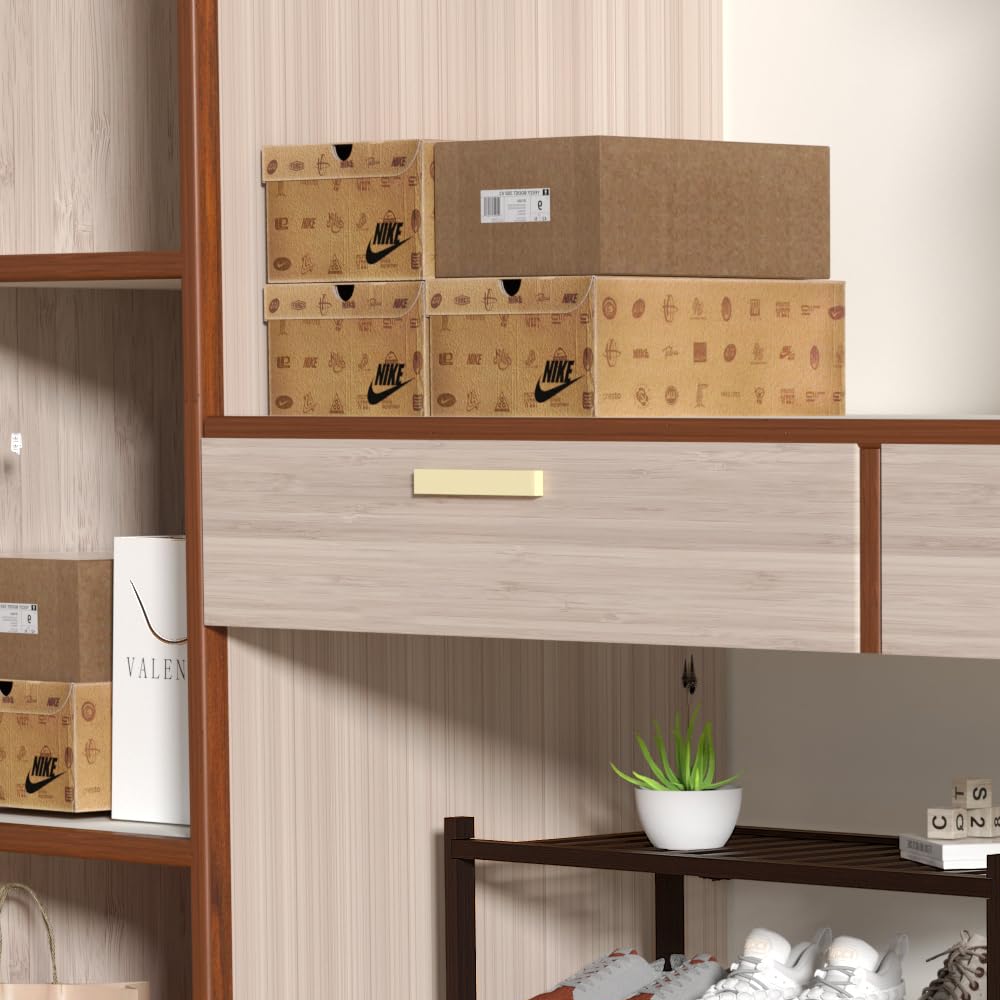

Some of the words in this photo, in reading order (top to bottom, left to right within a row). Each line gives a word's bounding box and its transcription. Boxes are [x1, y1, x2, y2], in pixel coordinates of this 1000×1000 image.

[373, 222, 404, 245] NIKE
[374, 363, 405, 386] NIKE
[542, 360, 575, 384] NIKE
[126, 656, 186, 680] VALEN
[31, 756, 58, 777] NIKE
[972, 786, 987, 801] S
[932, 815, 947, 830] C
[970, 816, 986, 828] 2
